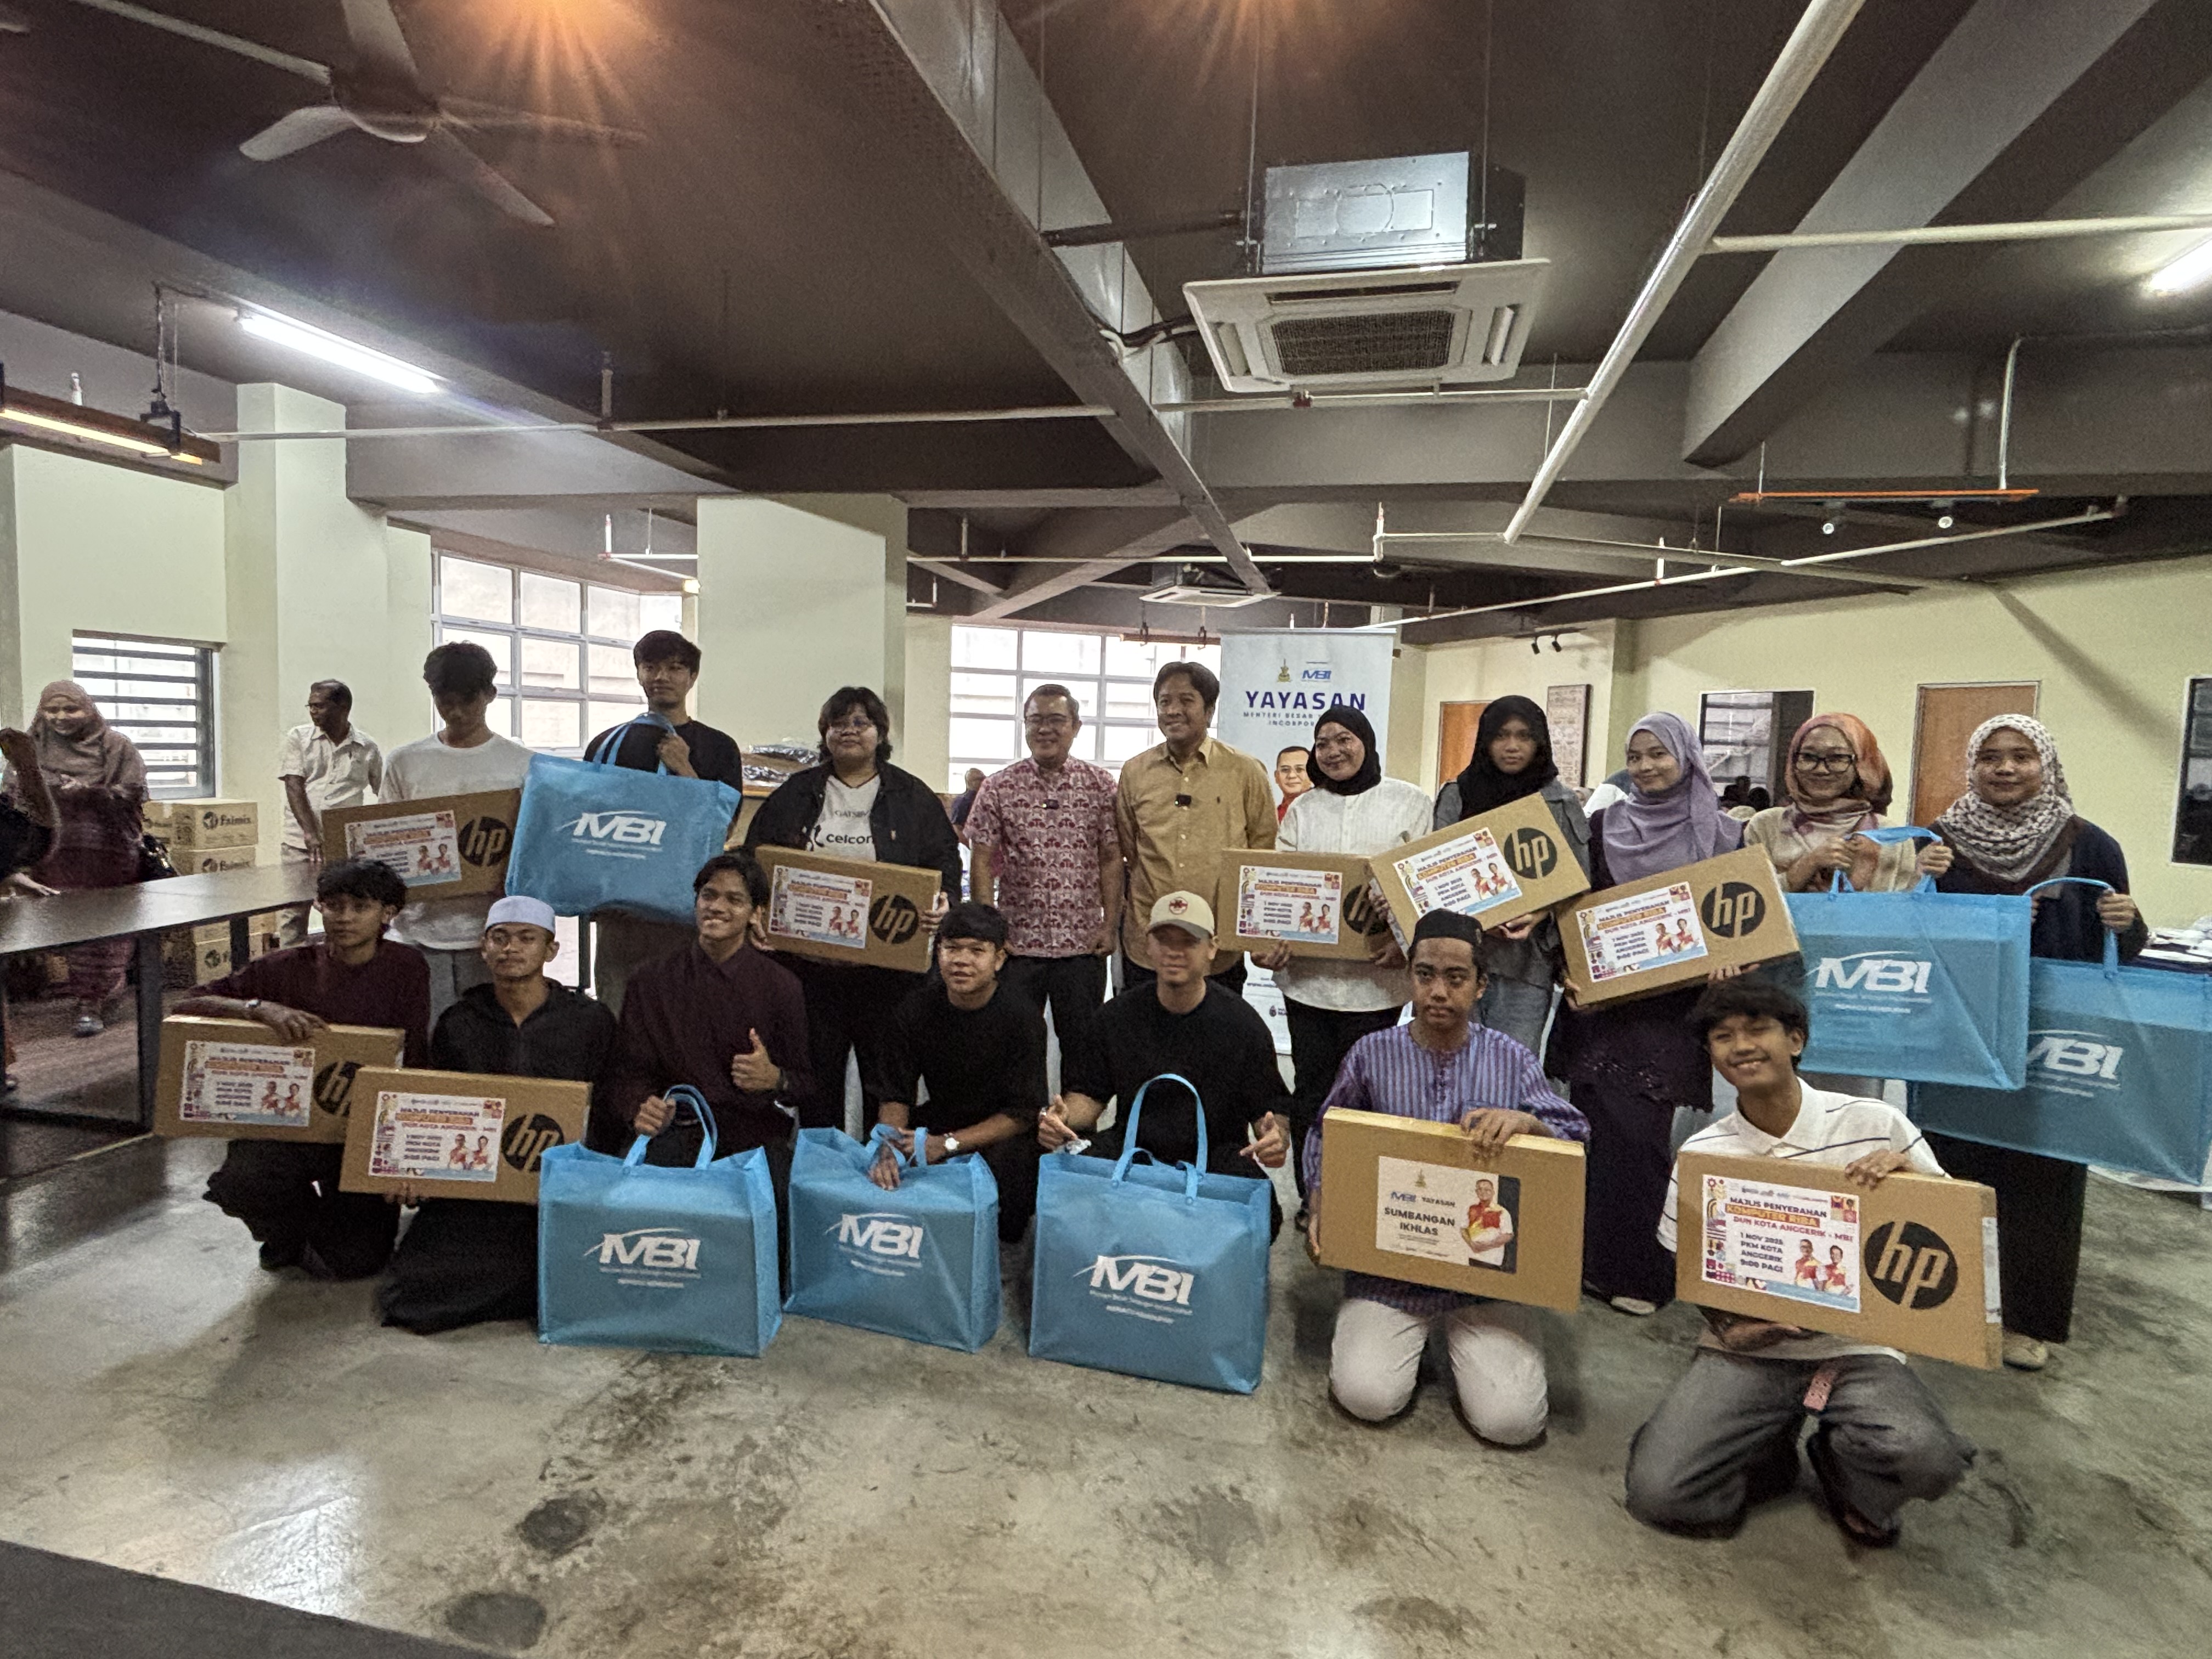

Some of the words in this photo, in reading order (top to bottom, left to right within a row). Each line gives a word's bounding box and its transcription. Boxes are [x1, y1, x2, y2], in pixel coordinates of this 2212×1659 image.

[1245, 691, 1365, 710] YAYASAN
[464, 817, 505, 867] hp
[573, 812, 667, 845] MBI
[1511, 828, 1550, 879] hp
[873, 894, 915, 944] hp
[1712, 882, 1756, 939] hp
[1815, 957, 1932, 994] MBI
[507, 1114, 560, 1172] hp
[1385, 1207, 1455, 1226] SUMBANGAN
[1730, 1197, 1761, 1207] MAJLIS
[1763, 1201, 1827, 1218] PENYERAHAN
[1754, 1219, 1778, 1229] KOTA
[839, 1214, 923, 1259] MBI
[1400, 1222, 1438, 1235] IKHLAS
[1746, 1233, 1763, 1241] NOV
[600, 1234, 701, 1270] MBI
[1760, 1245, 1783, 1254] KOTA
[1874, 1221, 1950, 1308] hp
[1090, 1255, 1194, 1305] MBI
